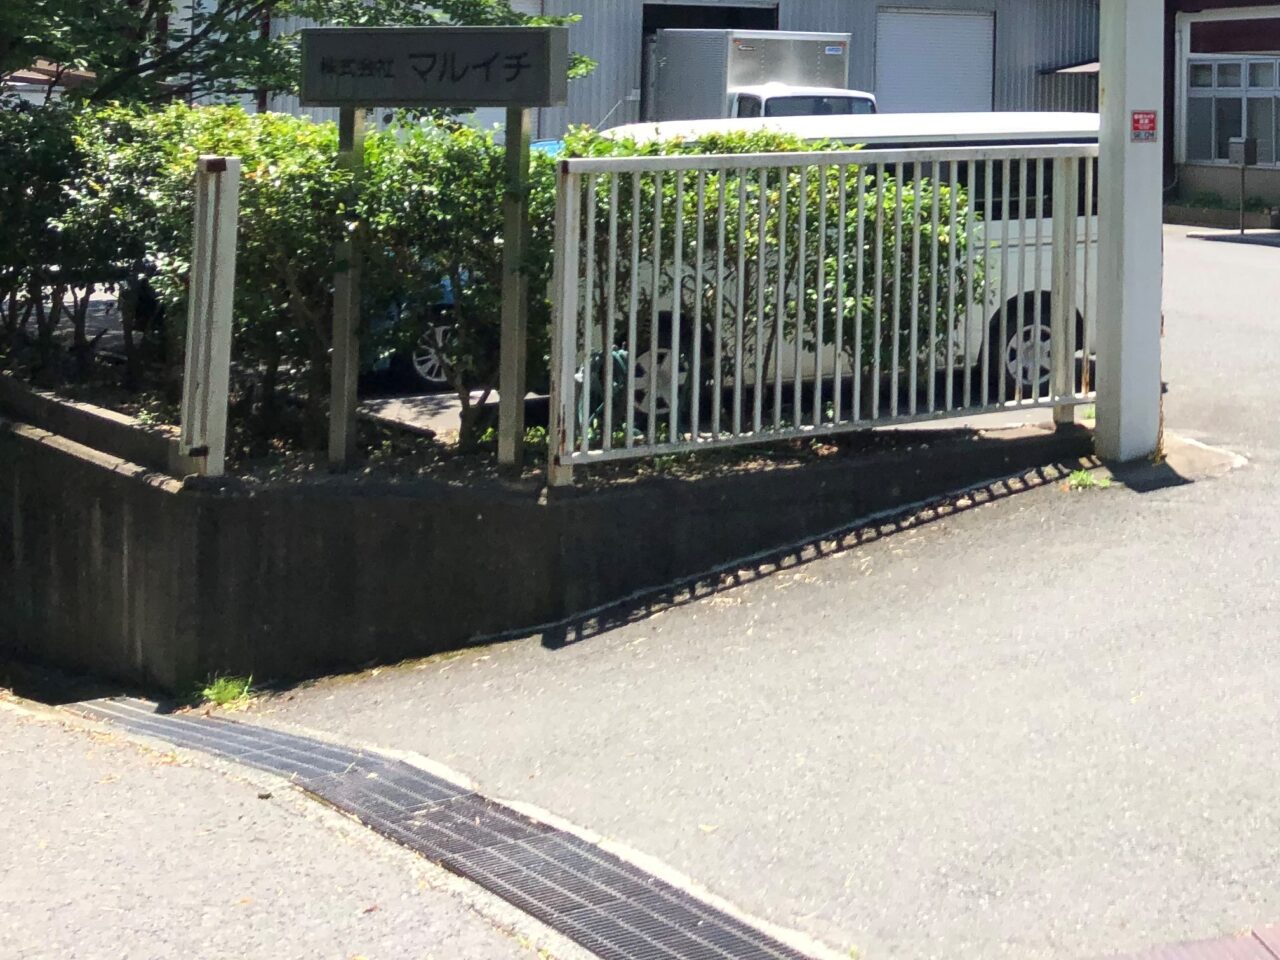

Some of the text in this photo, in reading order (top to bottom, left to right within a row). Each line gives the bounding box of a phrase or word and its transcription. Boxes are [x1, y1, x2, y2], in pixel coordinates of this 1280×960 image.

[320, 51, 532, 83] 株式会社 マルイチ
